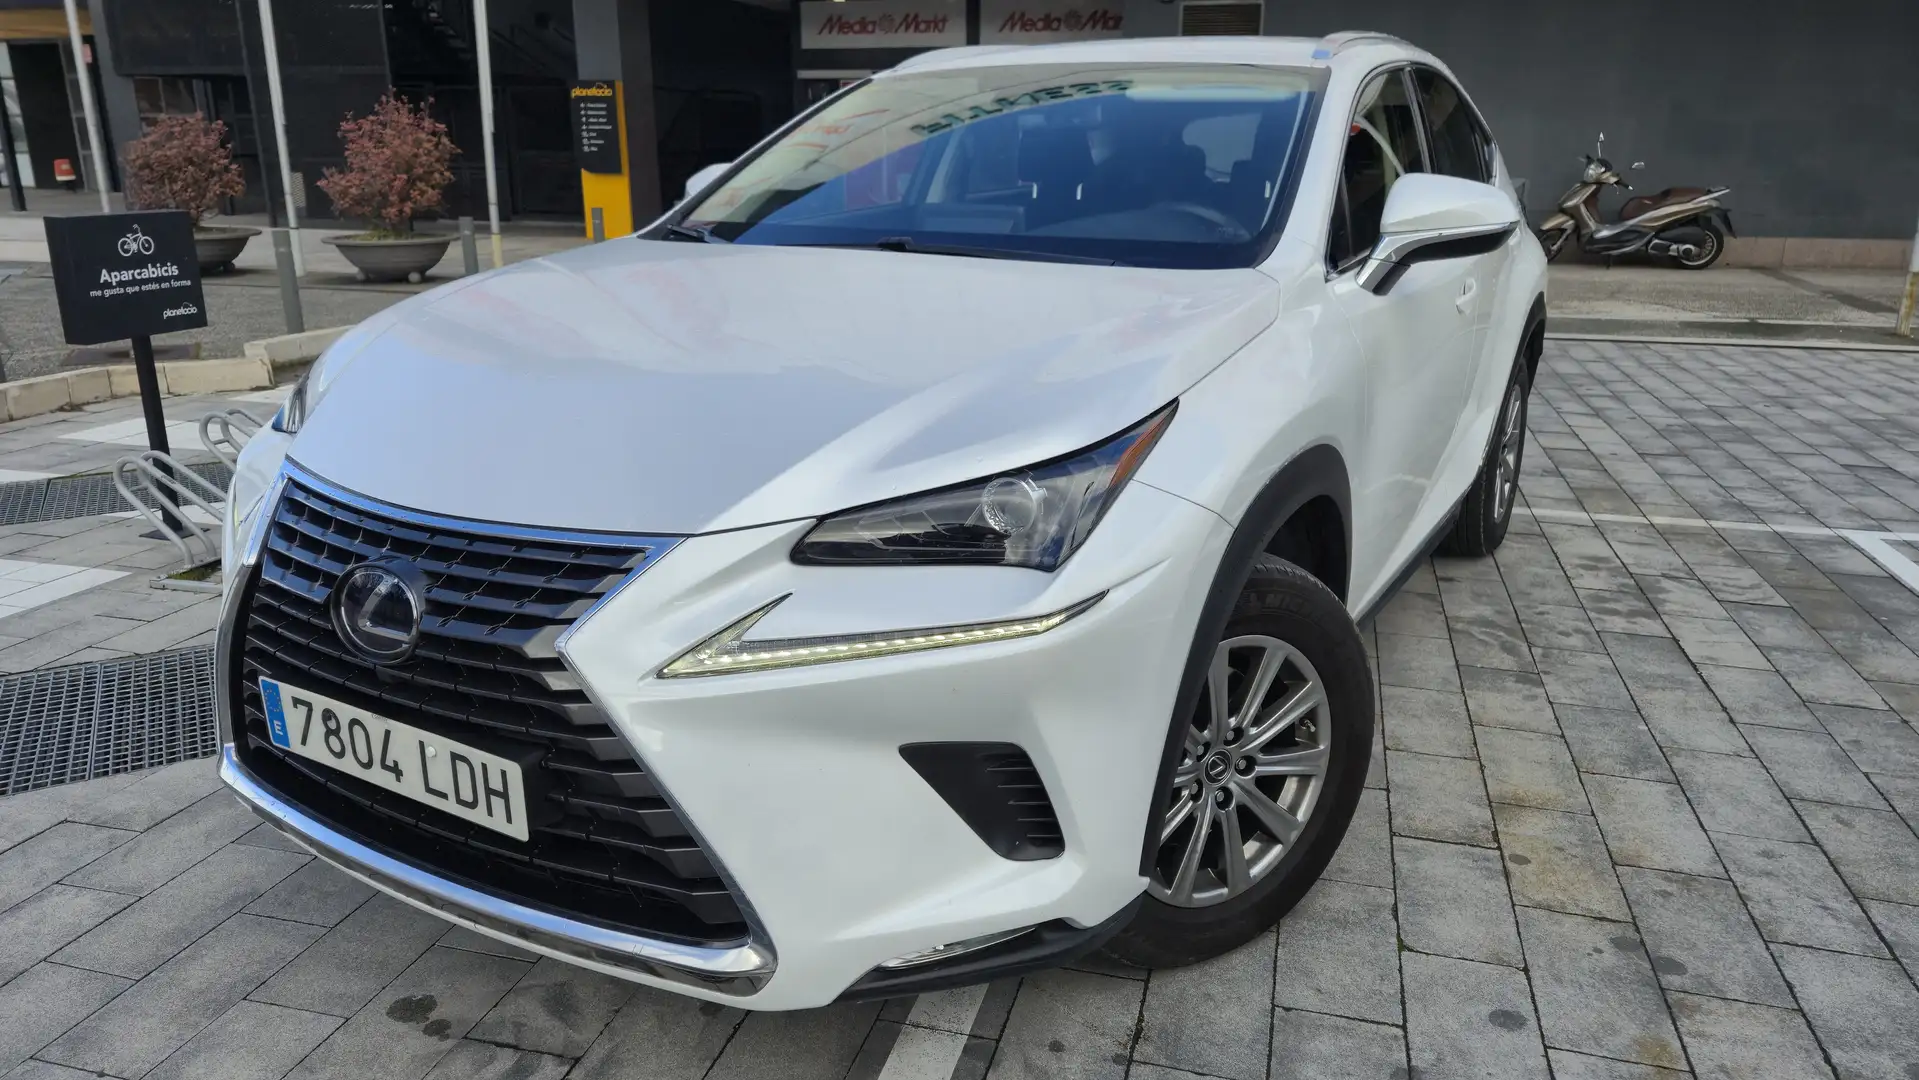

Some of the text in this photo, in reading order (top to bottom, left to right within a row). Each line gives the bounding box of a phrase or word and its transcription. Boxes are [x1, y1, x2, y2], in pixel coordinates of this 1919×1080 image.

[817, 12, 949, 35] Media Markt
[998, 10, 1062, 33] Media
[100, 262, 179, 285] Aparcabicis
[103, 286, 124, 297] gusta
[125, 285, 140, 294] que
[141, 282, 160, 291] estés
[170, 279, 191, 287] forma
[273, 719, 284, 736] E
[291, 696, 513, 825] 7804 LDH
